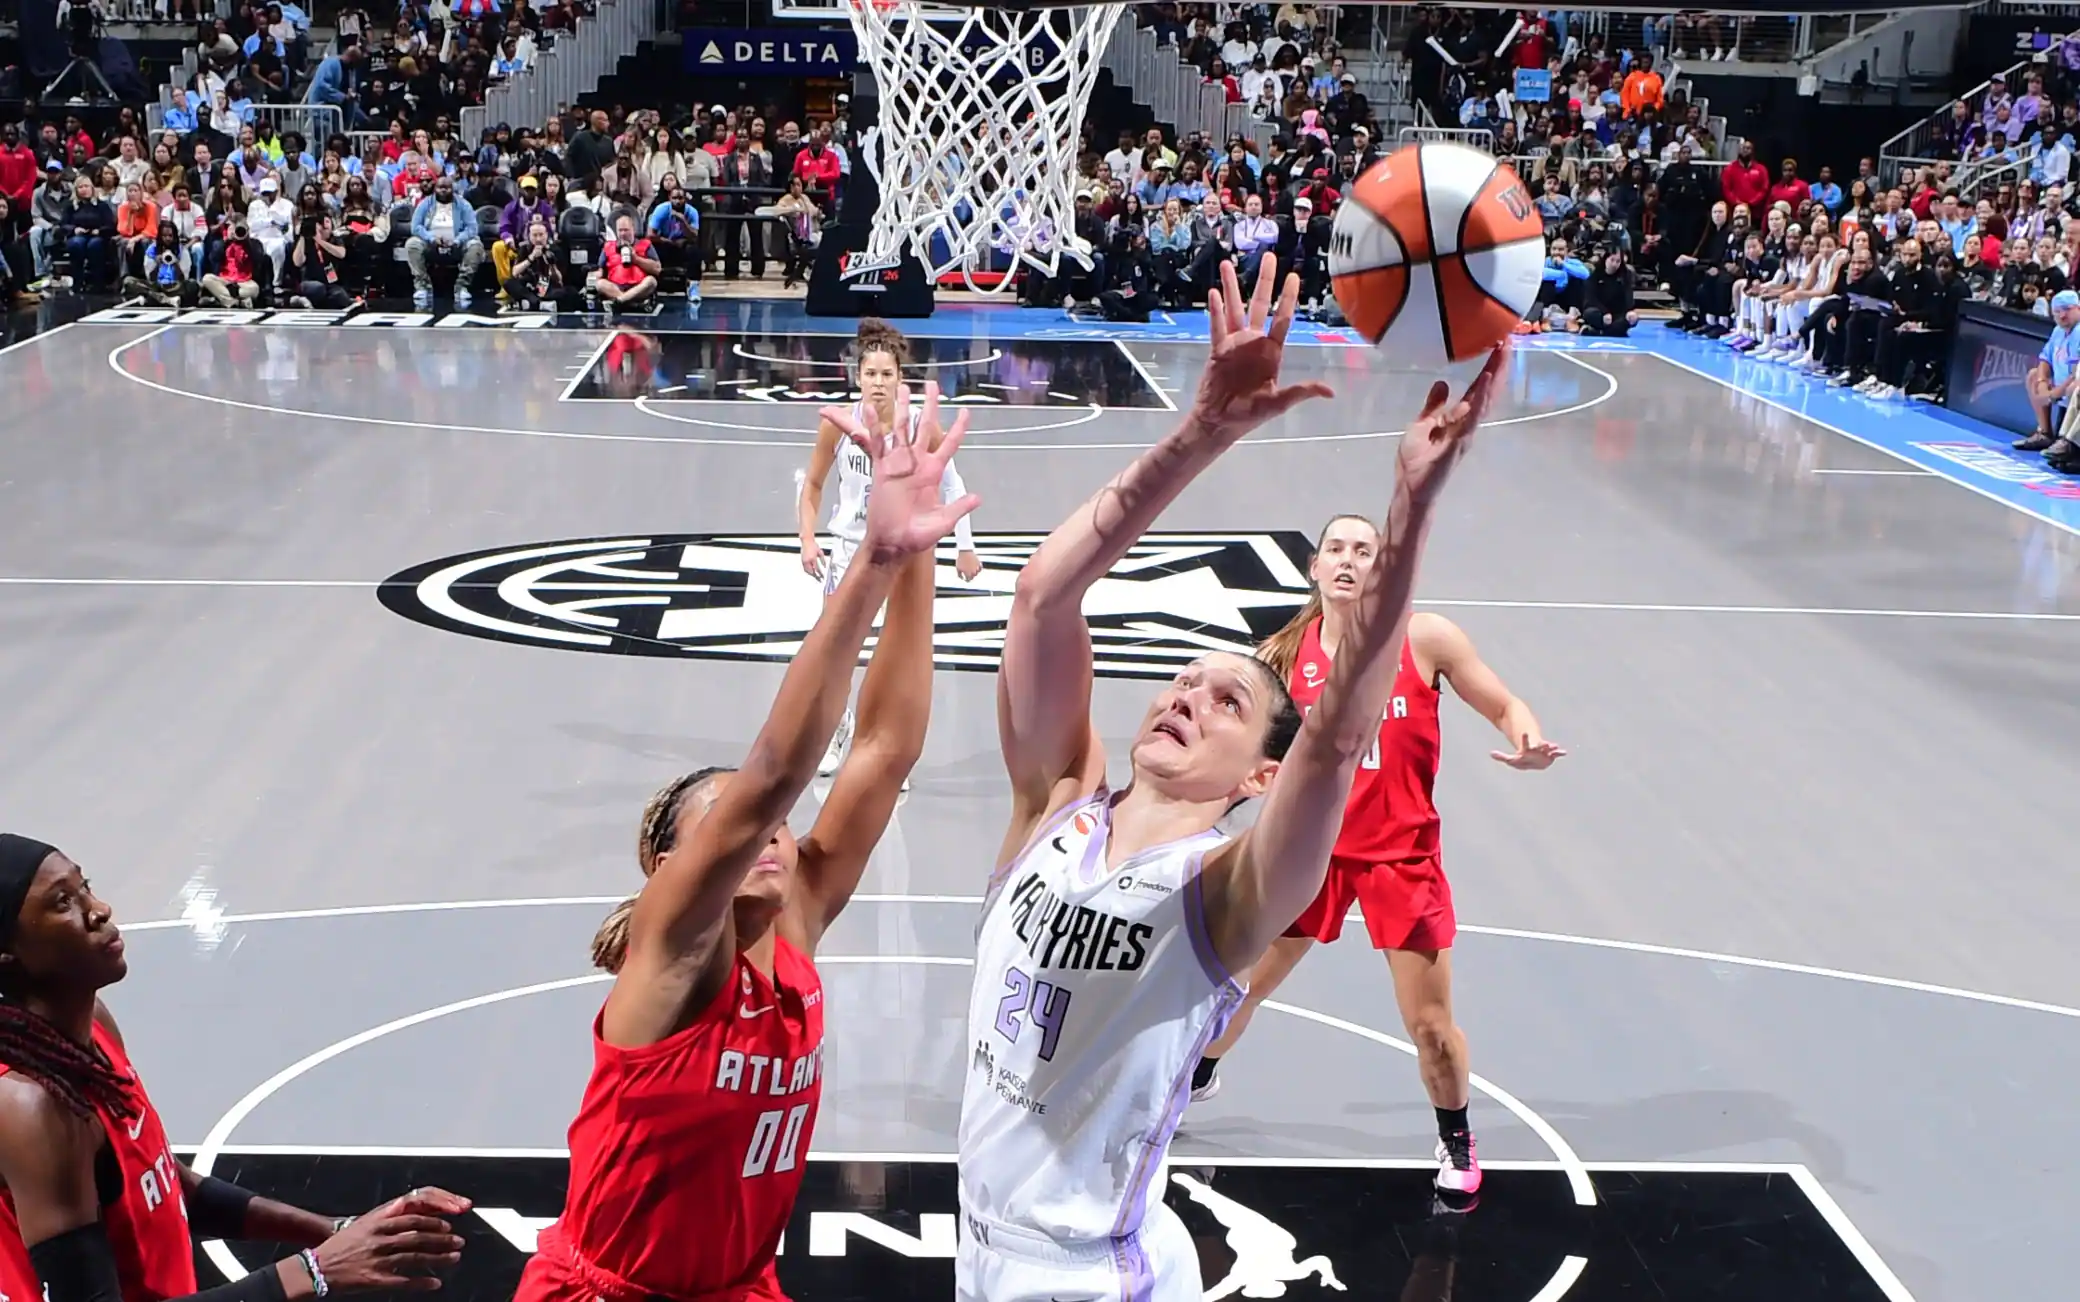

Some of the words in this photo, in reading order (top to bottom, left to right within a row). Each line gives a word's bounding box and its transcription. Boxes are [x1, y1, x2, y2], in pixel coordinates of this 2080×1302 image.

[734, 41, 840, 63] DELTA
[77, 309, 553, 329] DREAM
[1009, 872, 1154, 971] VALKYRIES
[994, 966, 1072, 1063] 24
[742, 1103, 809, 1179] 00
